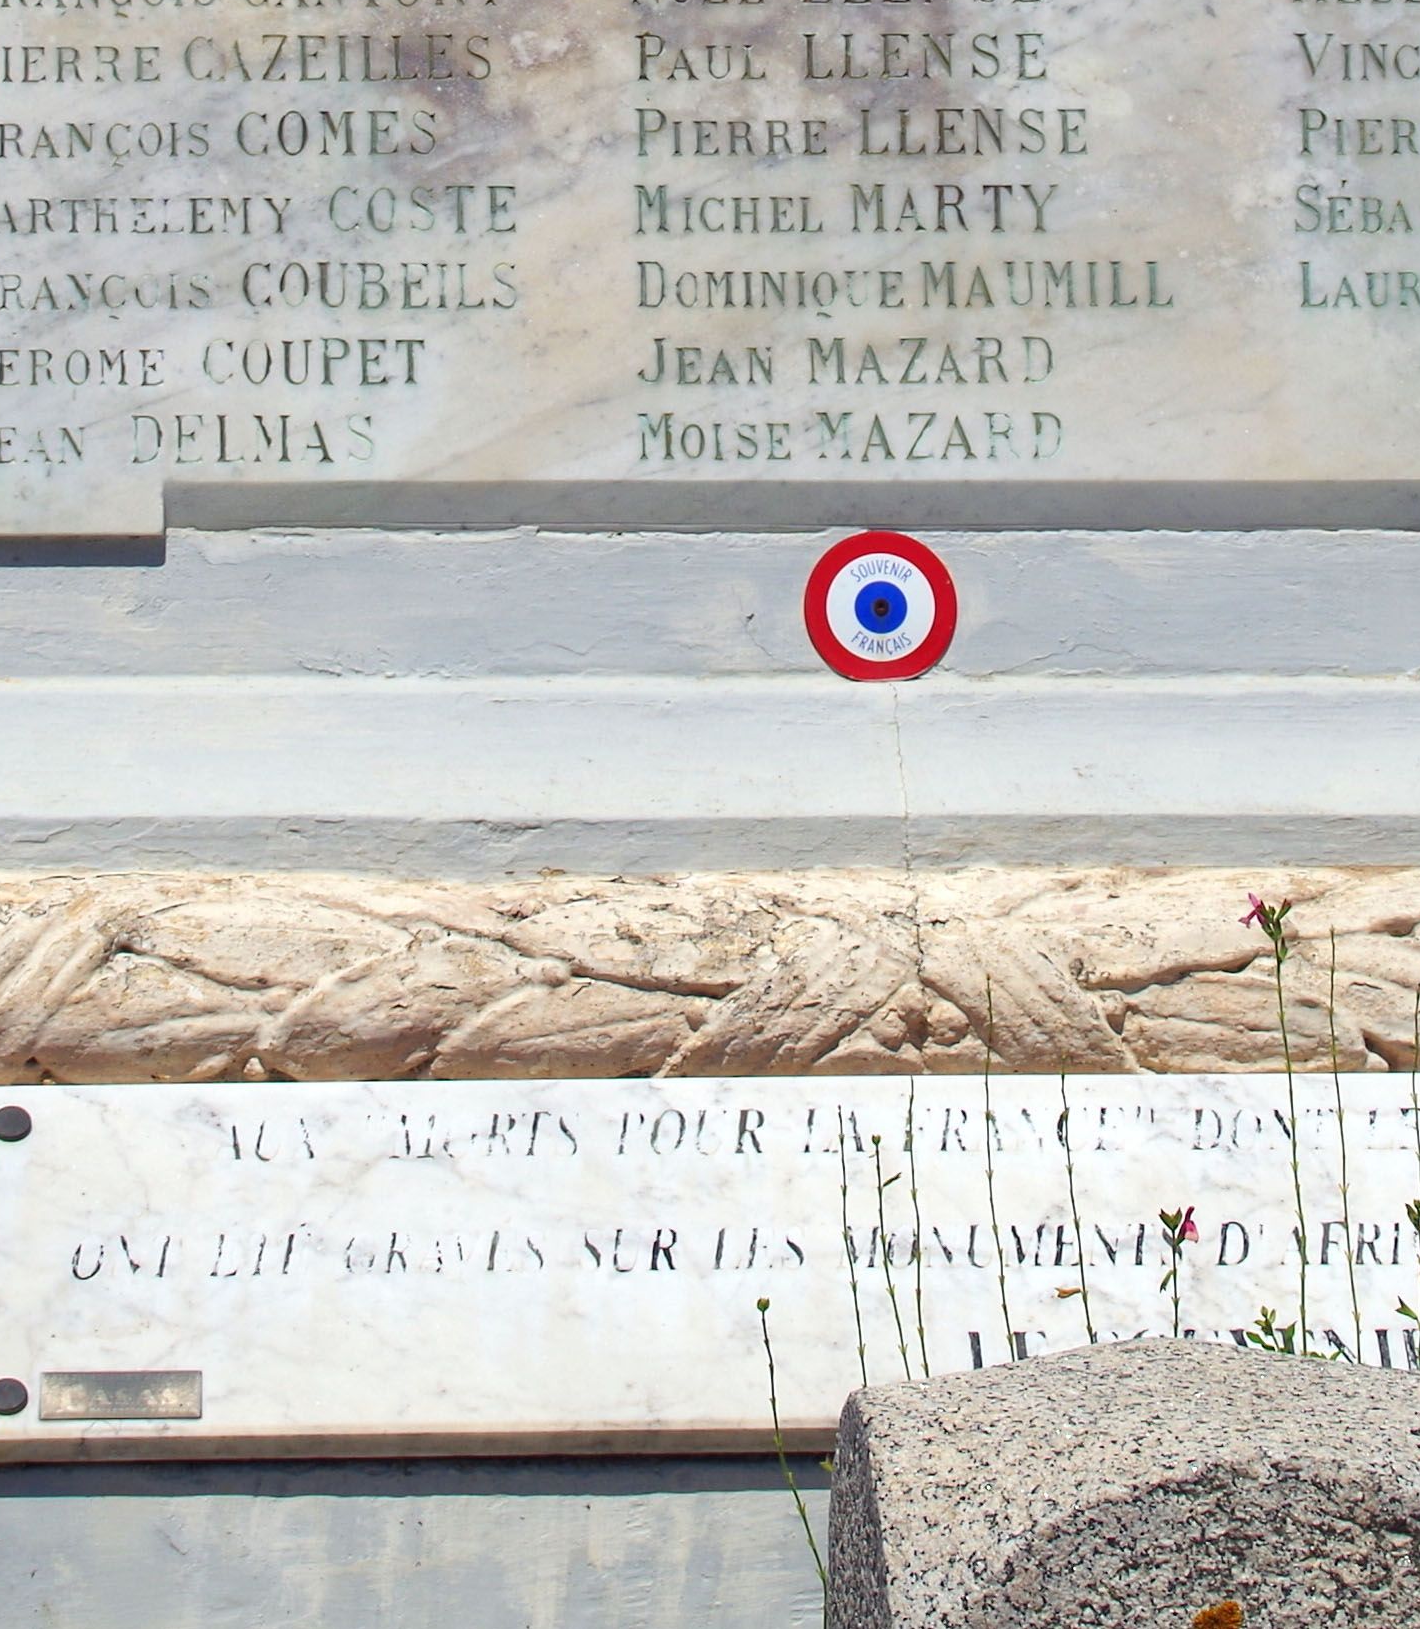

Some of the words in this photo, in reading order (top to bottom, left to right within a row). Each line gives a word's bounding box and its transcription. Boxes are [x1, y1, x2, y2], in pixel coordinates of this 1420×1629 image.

[183, 34, 493, 82] CAZEILLES
[634, 33, 768, 82] PAUL
[802, 33, 1048, 80] LLENSE
[236, 110, 438, 158] COMES
[634, 108, 829, 158] PIERRE
[859, 108, 1091, 157] LLENSE
[328, 184, 518, 234] COSTE
[634, 184, 824, 234] MICHEL
[850, 184, 1060, 234] MARTY
[242, 261, 519, 310] COUBEILS
[636, 261, 906, 318] DOMINIQUE
[921, 261, 1175, 309] MAUMILL
[202, 338, 426, 386] COUPET
[637, 338, 775, 386] JEAN
[807, 337, 1055, 385] MAZARD
[131, 414, 375, 464] DELMAS
[637, 413, 793, 462] MOISE
[816, 412, 1063, 462] MAZARD
[850, 559, 913, 583] SOUVENIR
[850, 630, 912, 655] FRANÇAIS
[617, 1108, 765, 1156] POUR
[801, 1107, 864, 1154] LA
[1192, 1107, 1341, 1151] DONT
[71, 1232, 173, 1280] ONT
[583, 1227, 678, 1274] SUR
[713, 1226, 806, 1271] LES
